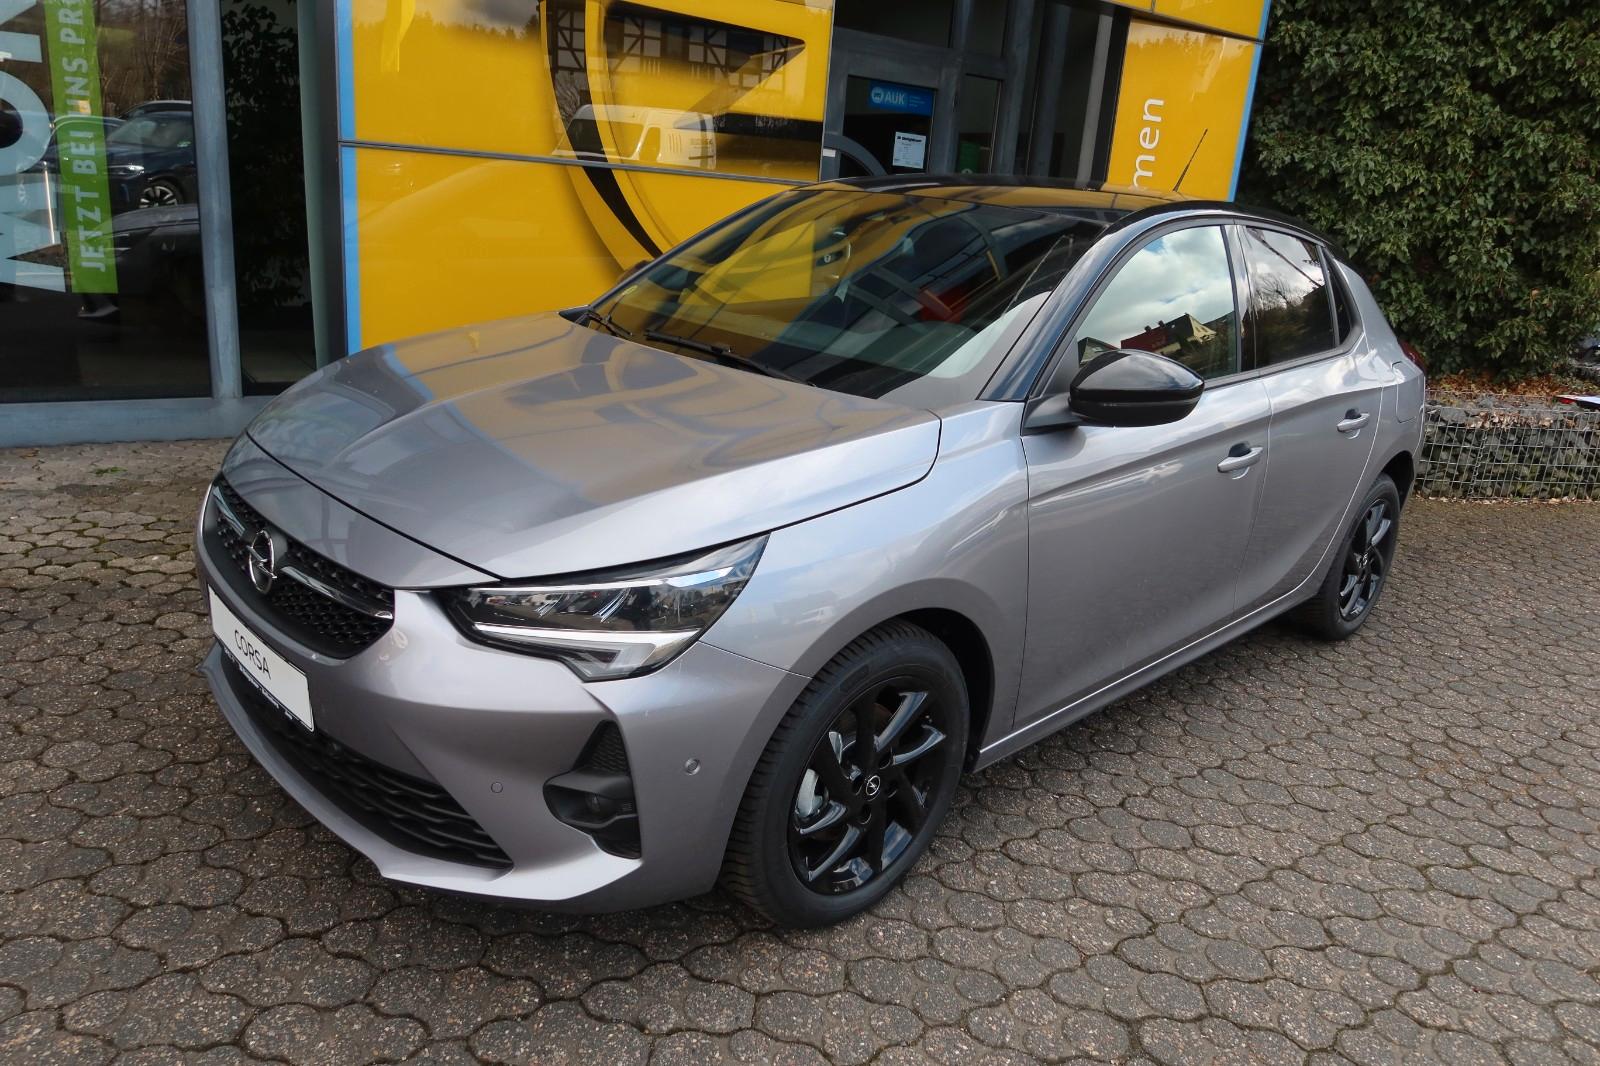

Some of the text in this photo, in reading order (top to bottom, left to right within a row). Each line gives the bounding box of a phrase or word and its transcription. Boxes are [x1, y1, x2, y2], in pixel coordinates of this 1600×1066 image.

[57, 0, 106, 272] JETZT BEI UNS PR
[234, 629, 271, 680] CORSA
